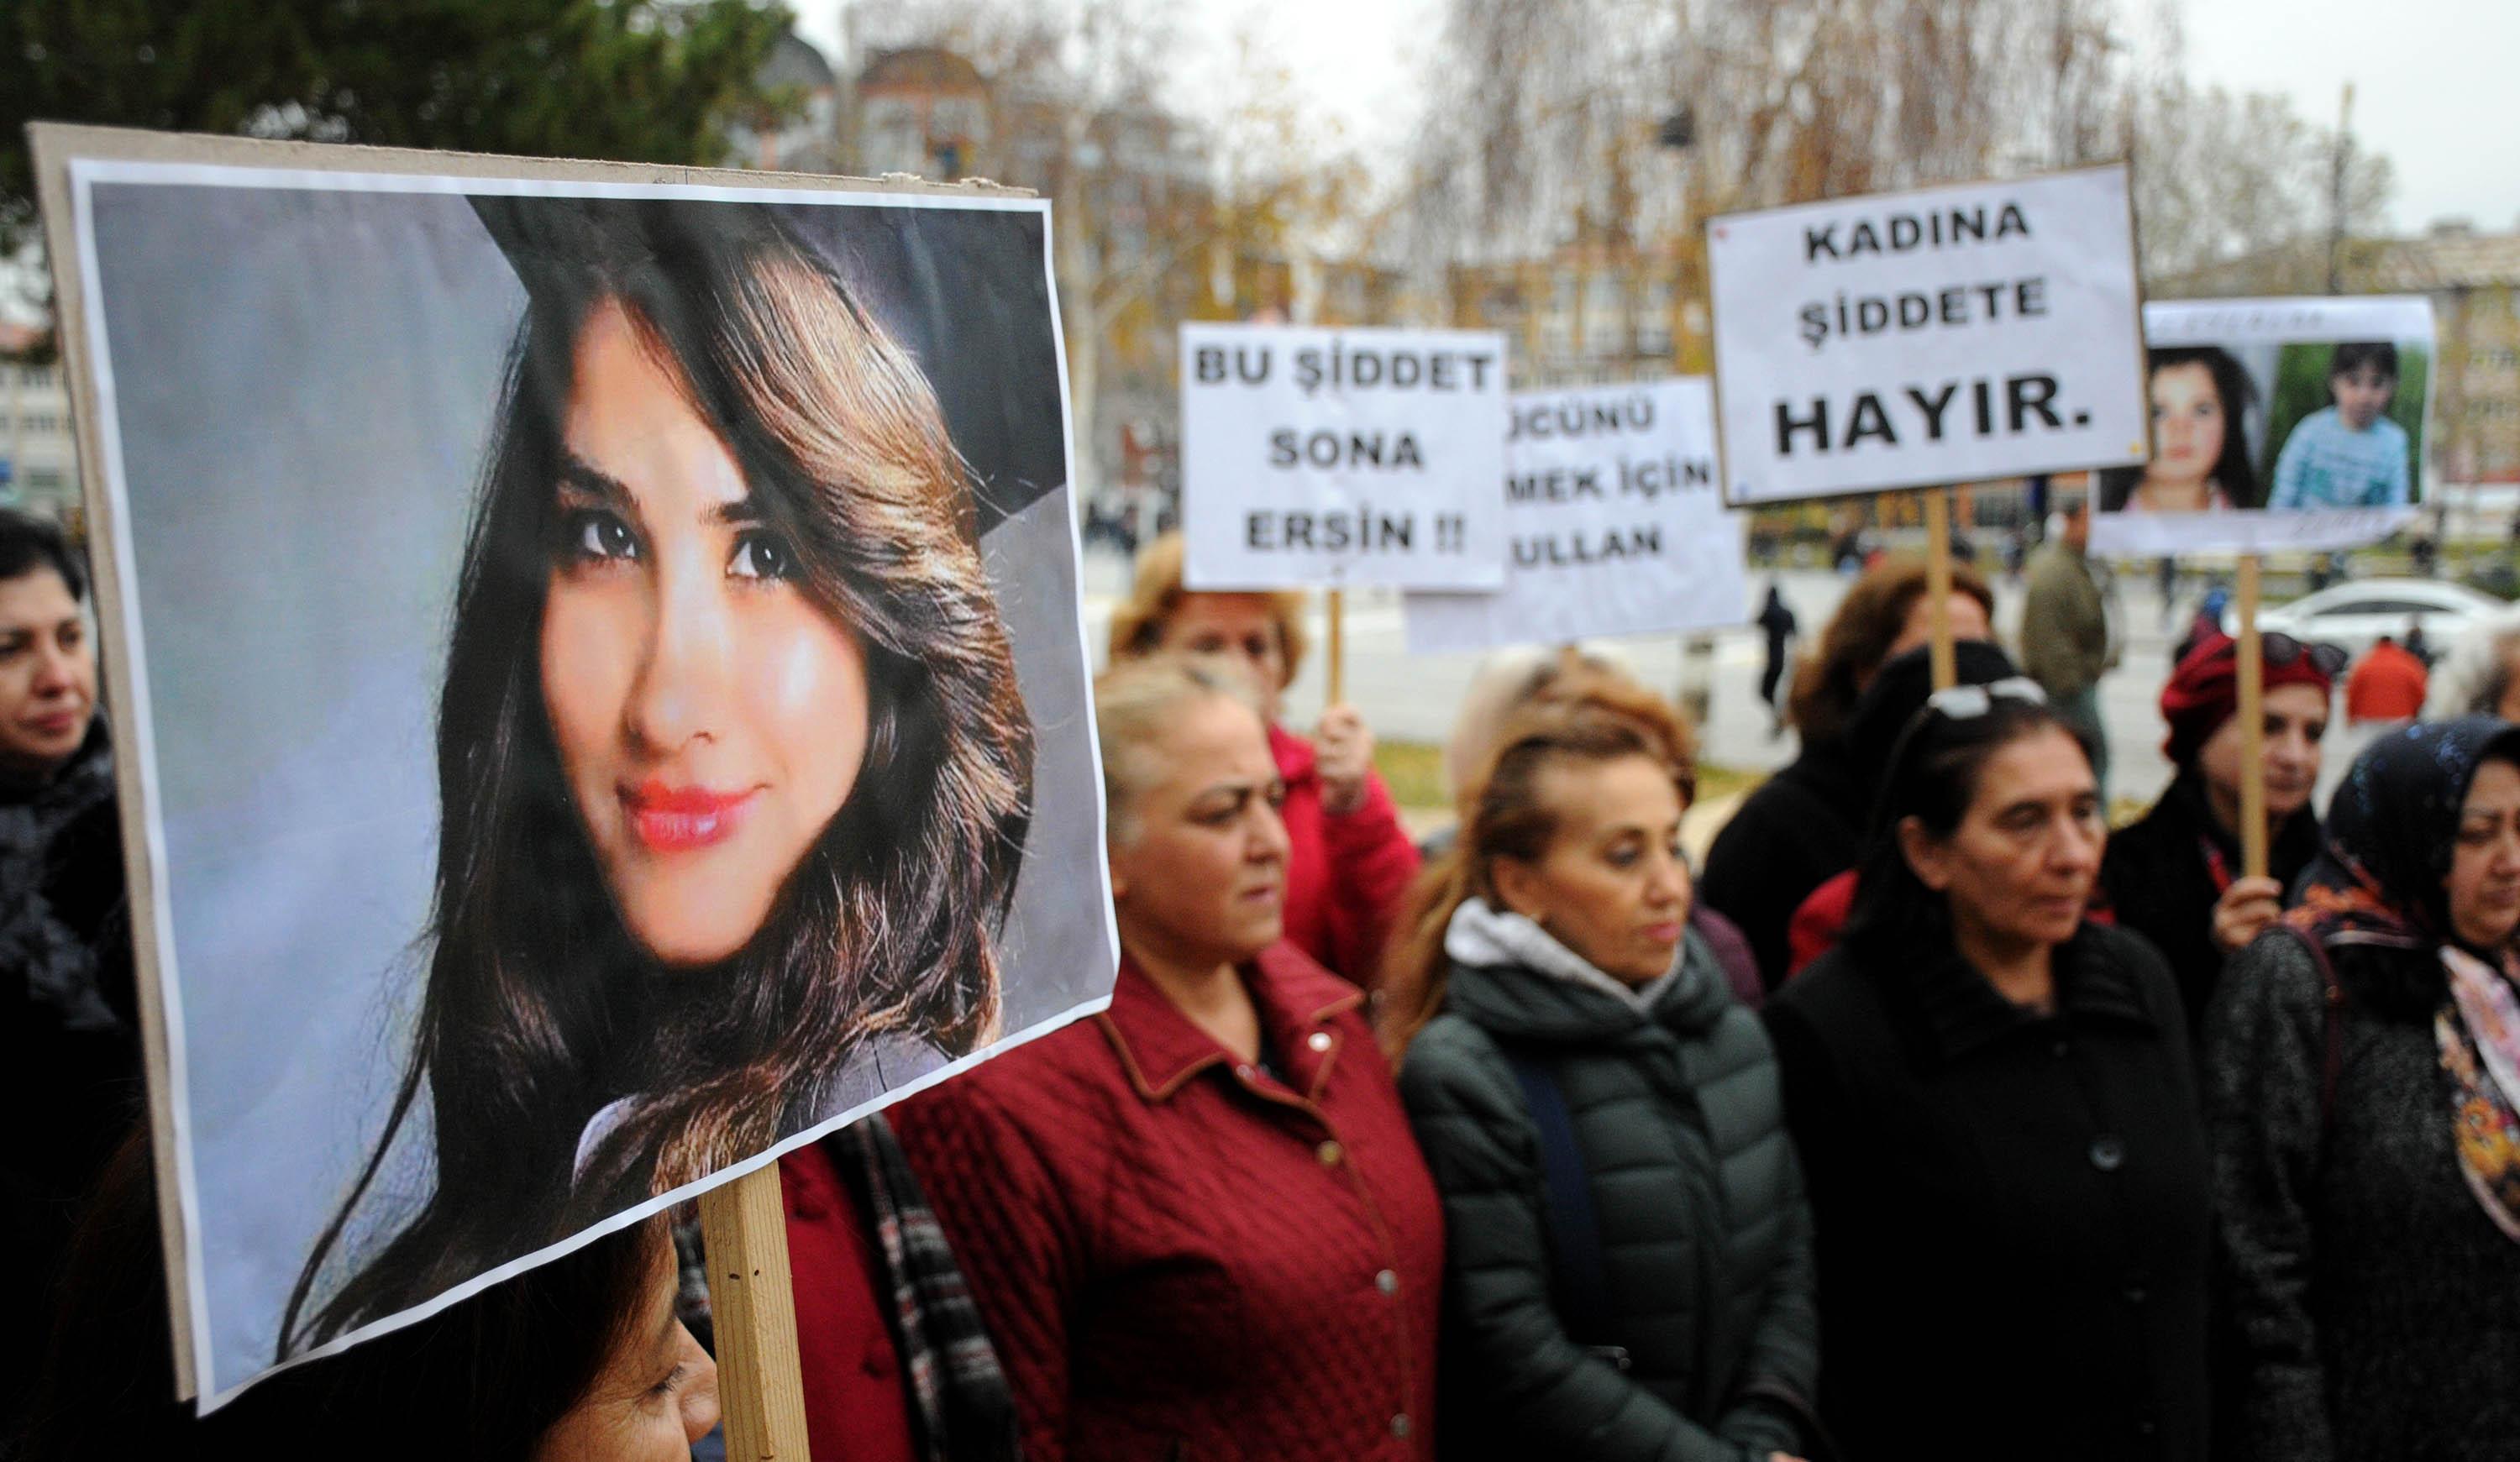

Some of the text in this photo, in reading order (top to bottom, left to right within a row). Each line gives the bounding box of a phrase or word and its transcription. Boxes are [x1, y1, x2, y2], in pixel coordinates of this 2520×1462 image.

[1803, 198, 2031, 263] KADINA
[1798, 277, 2048, 352] ŞİDDETE
[1195, 336, 1493, 395] BU ŞİDDET
[1774, 373, 2093, 457] HAYIR.
[1268, 427, 1426, 470] SONA
[1619, 453, 1710, 499] İÇİN
[1245, 502, 1467, 555] ERSİN !!
